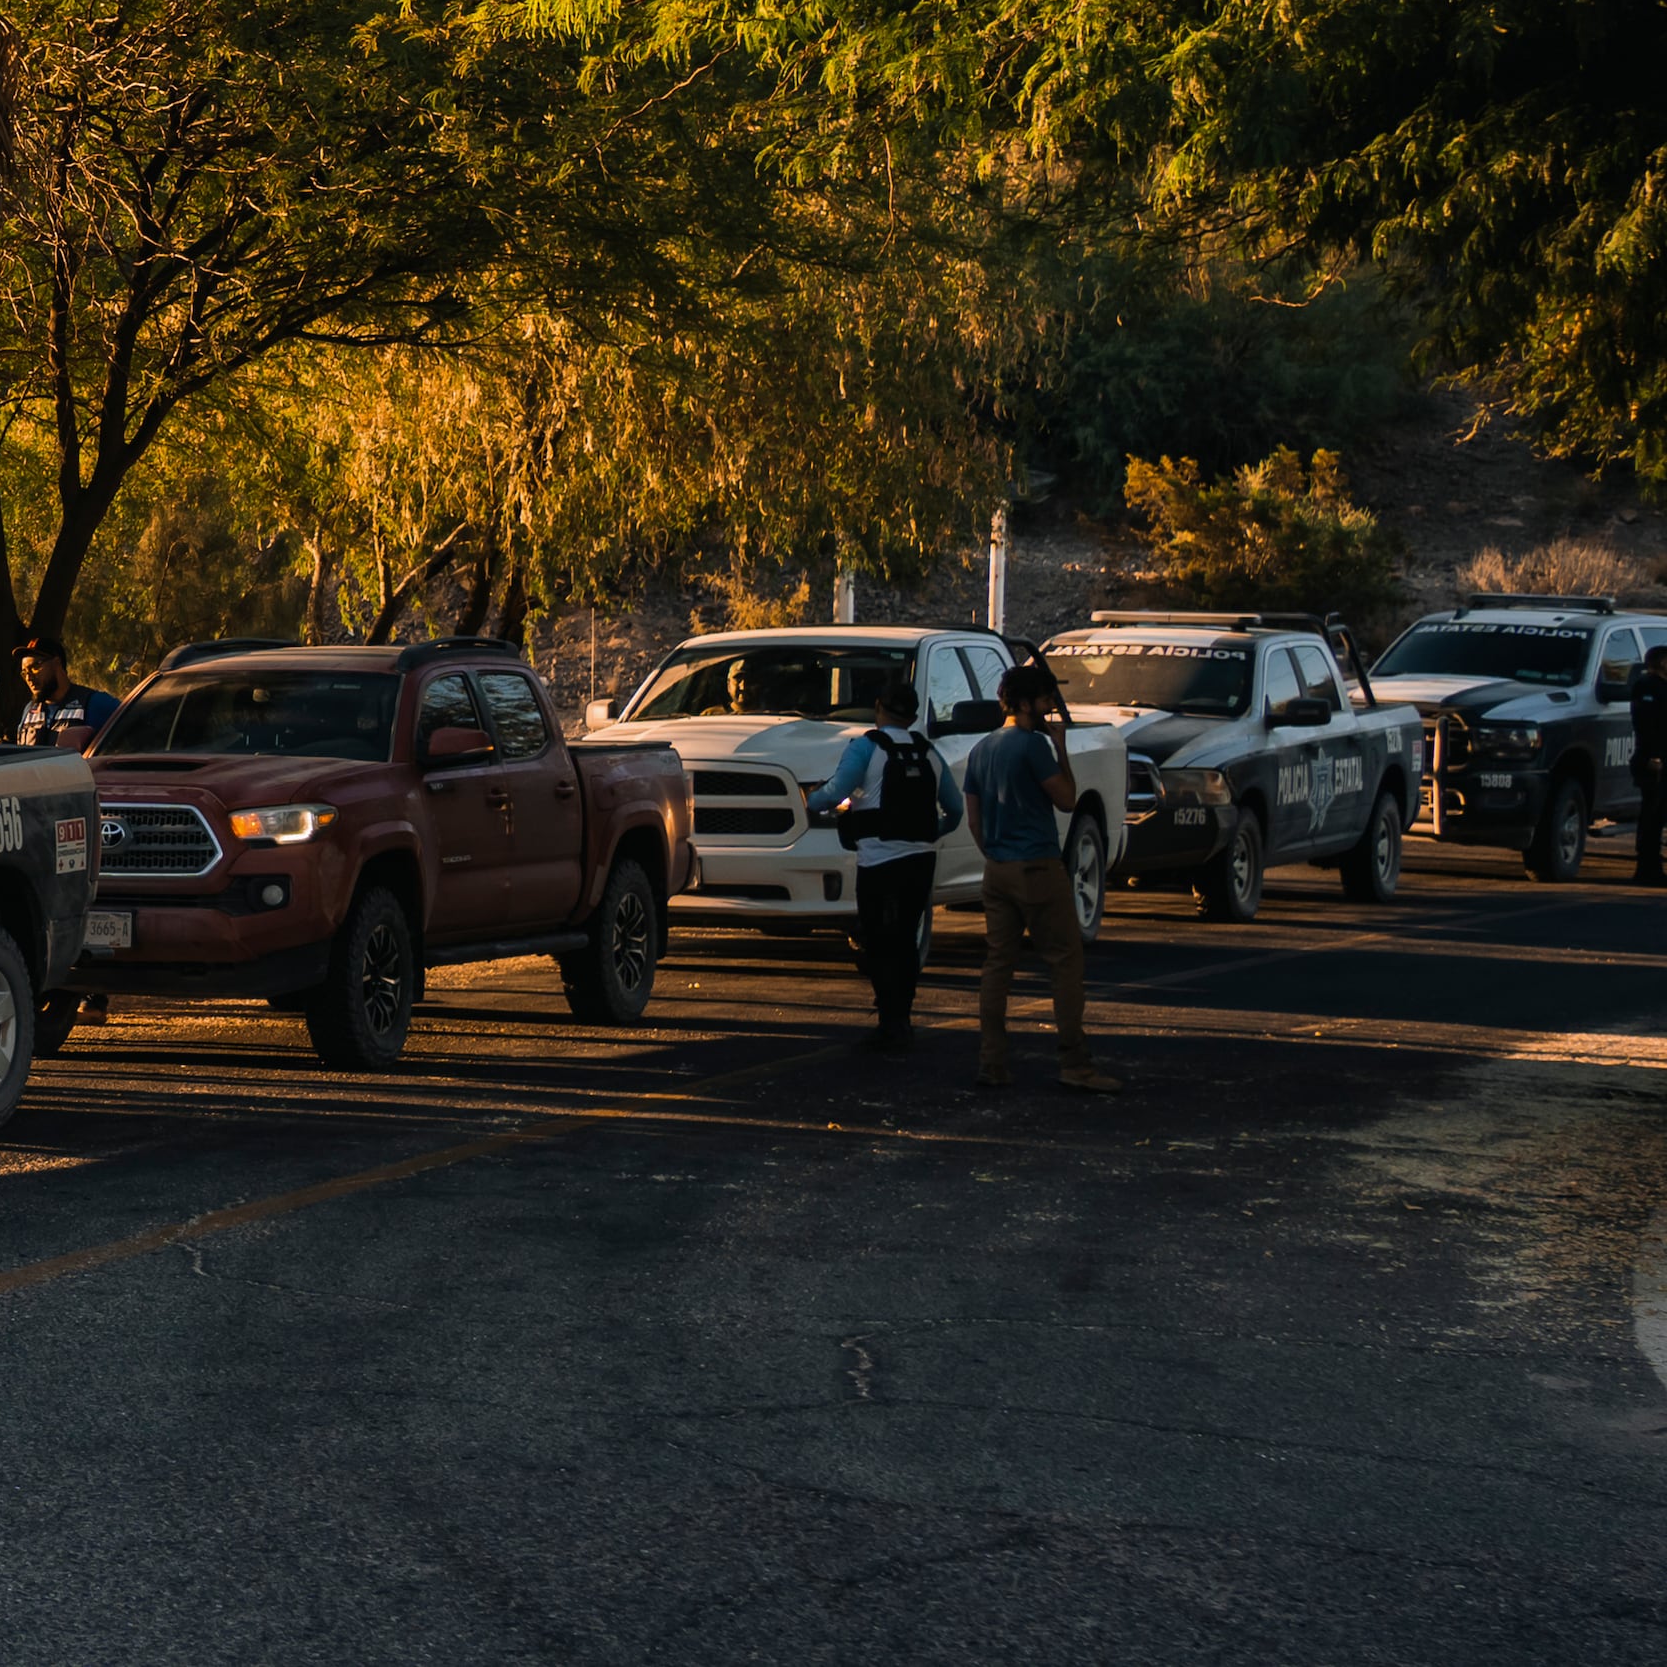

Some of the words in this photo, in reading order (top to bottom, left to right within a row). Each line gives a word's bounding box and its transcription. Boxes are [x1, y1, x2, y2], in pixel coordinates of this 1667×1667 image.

[1173, 806, 1207, 825] 15276
[58, 821, 84, 840] 911
[90, 920, 128, 937] 3665-A
